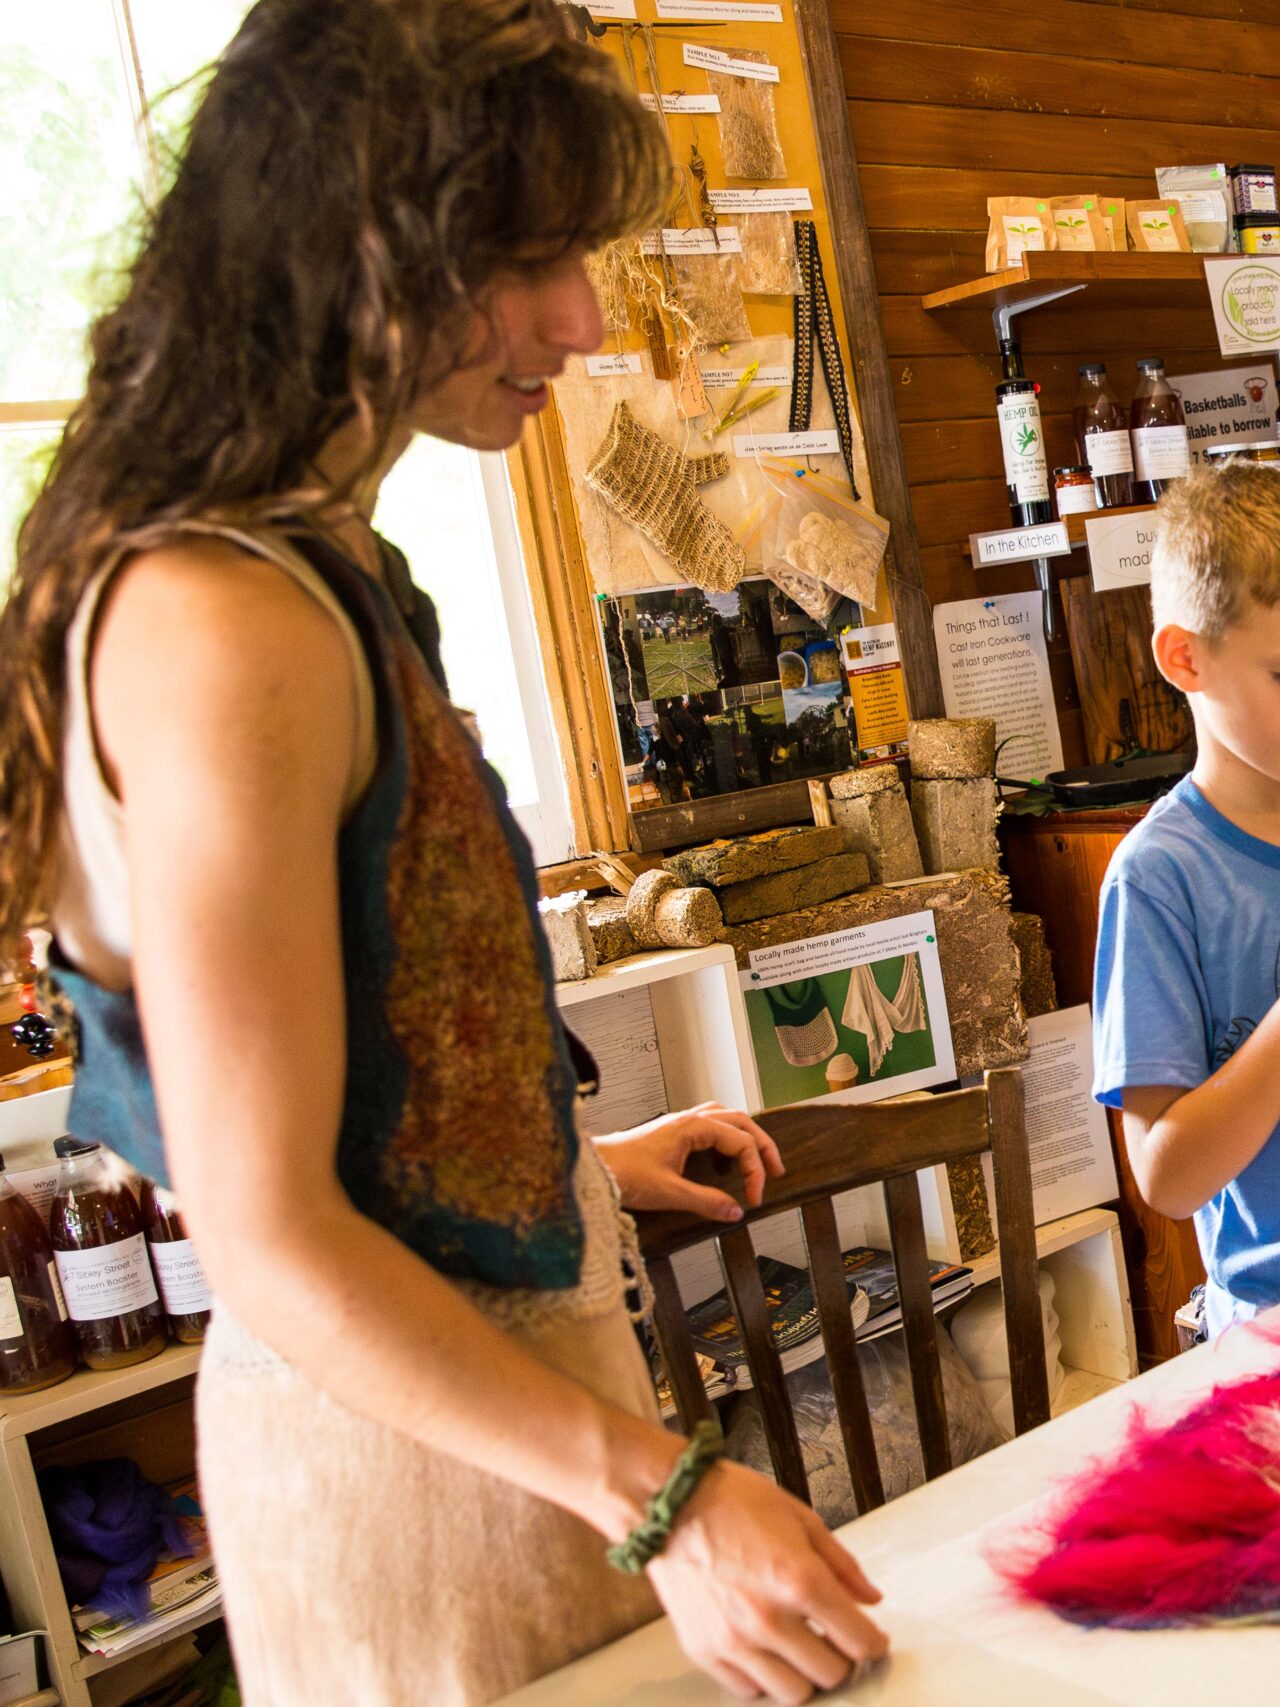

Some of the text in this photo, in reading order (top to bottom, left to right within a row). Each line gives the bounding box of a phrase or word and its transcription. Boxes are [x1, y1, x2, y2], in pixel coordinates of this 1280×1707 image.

[1229, 285, 1255, 299] Locally
[1256, 282, 1279, 295] made
[1241, 299, 1274, 313] products
[1245, 313, 1277, 327] sold here
[1184, 393, 1247, 414] Basketballs
[1004, 406, 1039, 421] HEMP OIL
[1187, 425, 1216, 440] ilable
[1220, 424, 1230, 435] to
[1233, 415, 1270, 433] borrow
[1192, 450, 1199, 464] 7
[986, 532, 1059, 555] In the Kitchen
[1119, 553, 1150, 568] mad
[946, 612, 1030, 637] Things that Last !
[863, 640, 895, 652] HEMP MASONRY
[949, 631, 1031, 653] Cast Iron Cookware
[951, 658, 965, 669] will
[966, 656, 980, 667] last
[754, 930, 866, 963] Locally made hemp garments
[33, 1178, 58, 1190] What
[76, 1267, 103, 1281] Sibley
[103, 1260, 131, 1275] Street
[76, 1271, 139, 1293] System Booster
[774, 1314, 812, 1340] Sculpted
